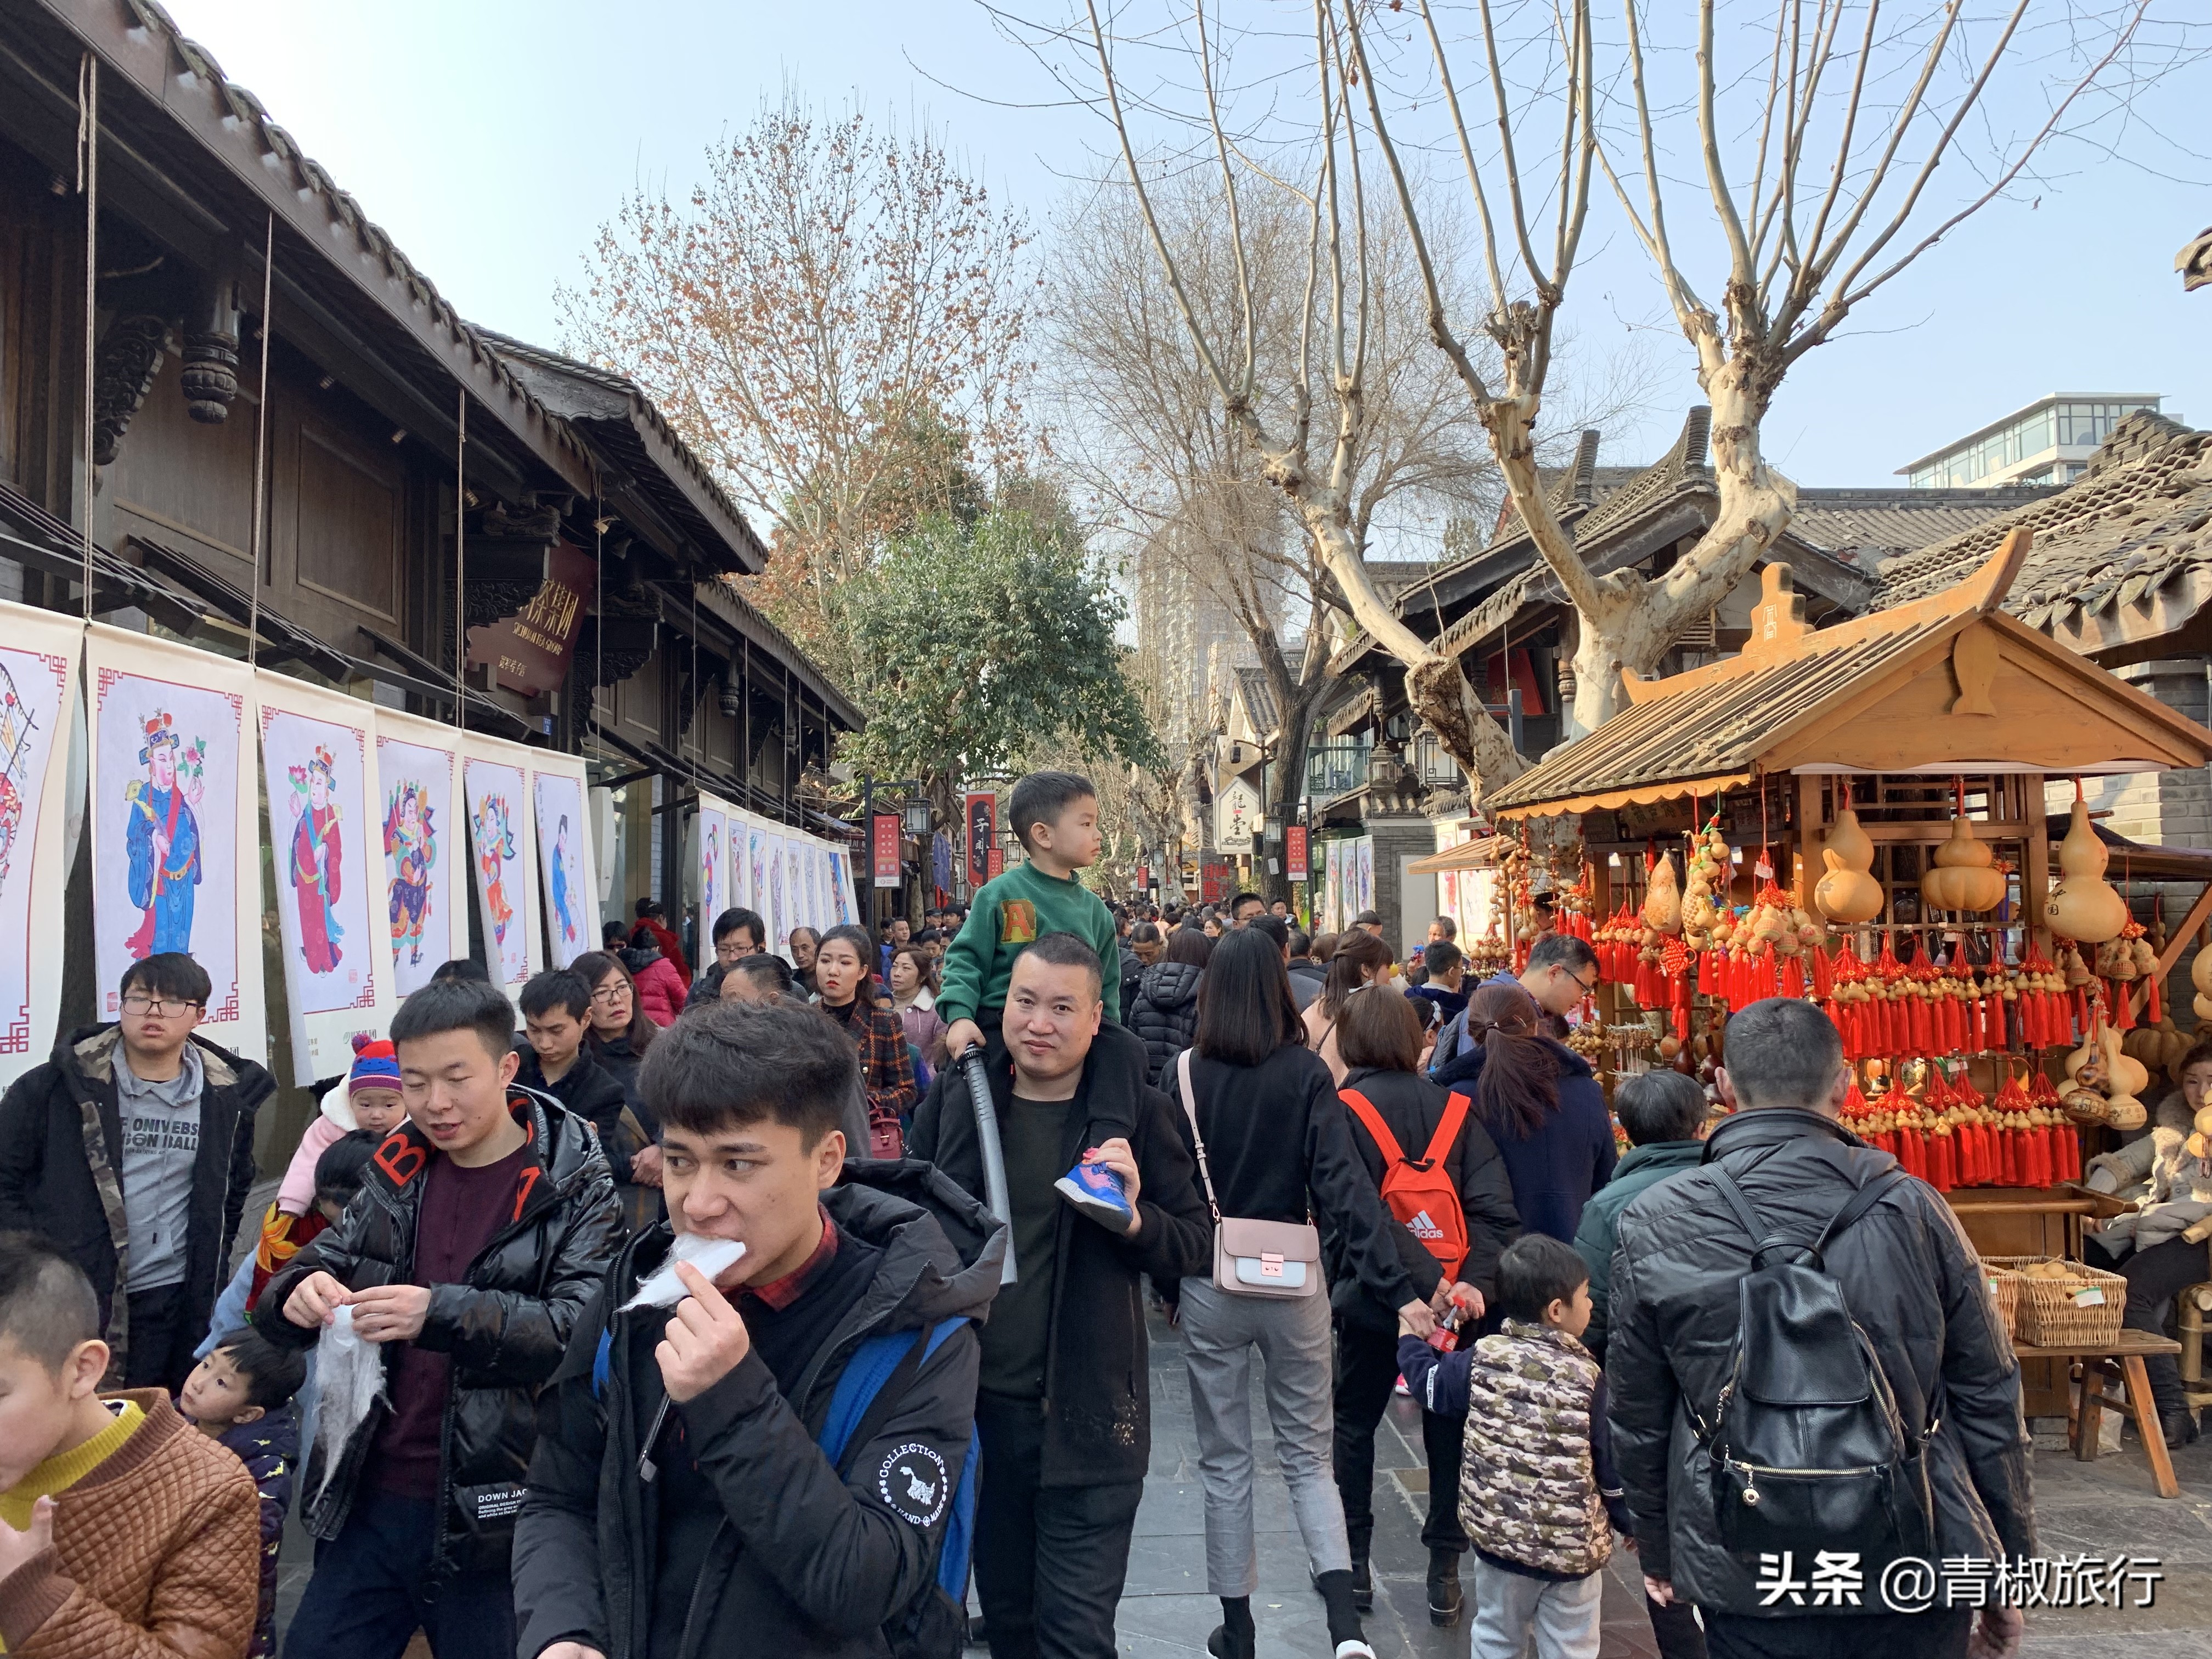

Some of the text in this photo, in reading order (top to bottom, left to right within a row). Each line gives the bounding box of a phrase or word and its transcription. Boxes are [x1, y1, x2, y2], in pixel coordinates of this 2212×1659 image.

[1005, 904, 1032, 938] A
[1408, 1228, 1444, 1238] didas
[879, 1443, 944, 1477] COLLECTION
[478, 1492, 508, 1503] DOWN
[897, 1500, 944, 1524] HAND MADE
